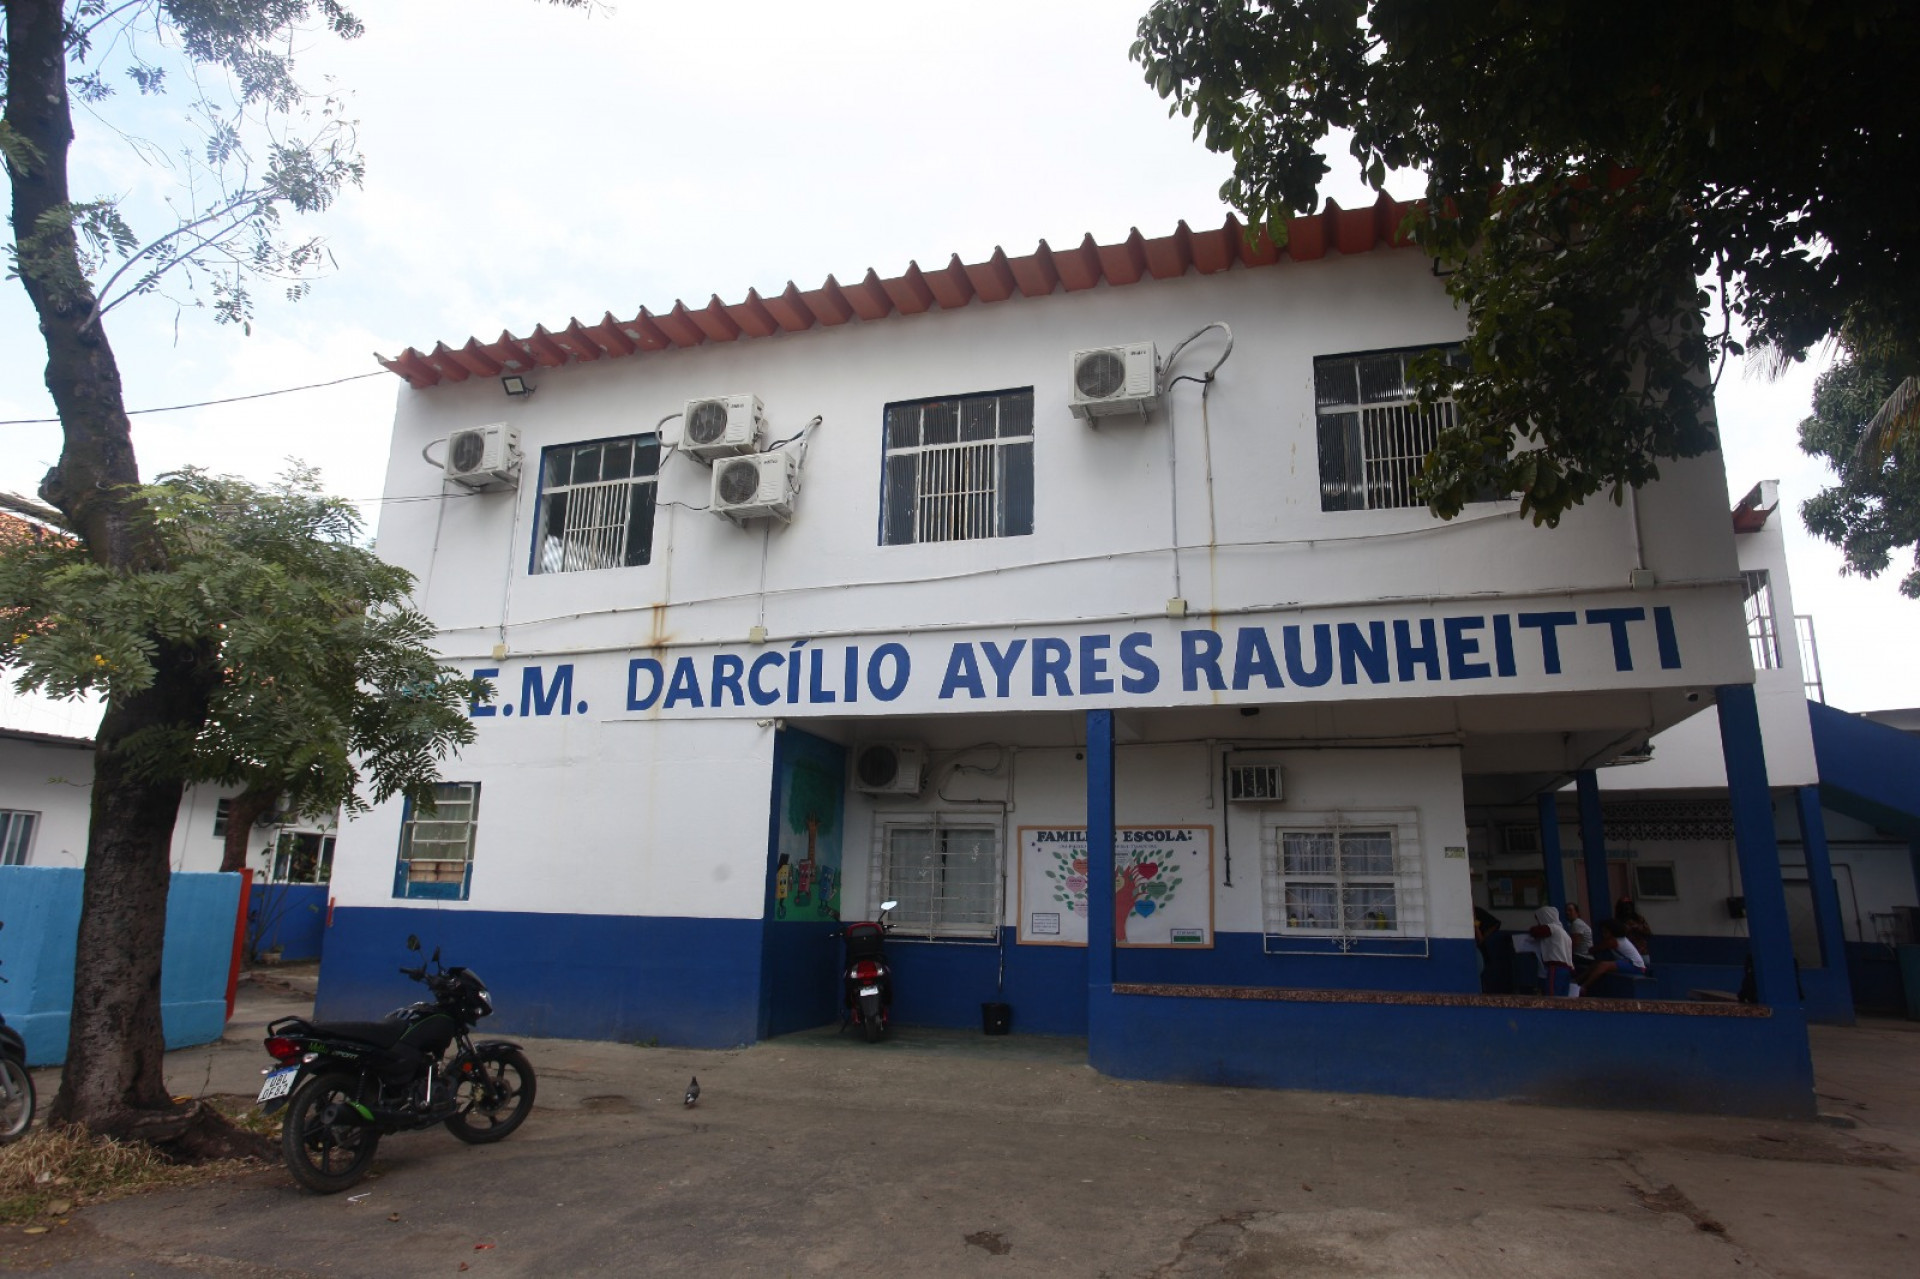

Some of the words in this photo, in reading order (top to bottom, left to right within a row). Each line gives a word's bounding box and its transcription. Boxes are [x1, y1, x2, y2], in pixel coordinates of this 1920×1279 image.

[470, 665, 589, 717] E.M.
[627, 640, 911, 711] DARCÍLIO
[939, 632, 1160, 699] AYRES
[1181, 606, 1682, 692] RAUNHEITTI
[1123, 830, 1192, 842] ESCOLA:
